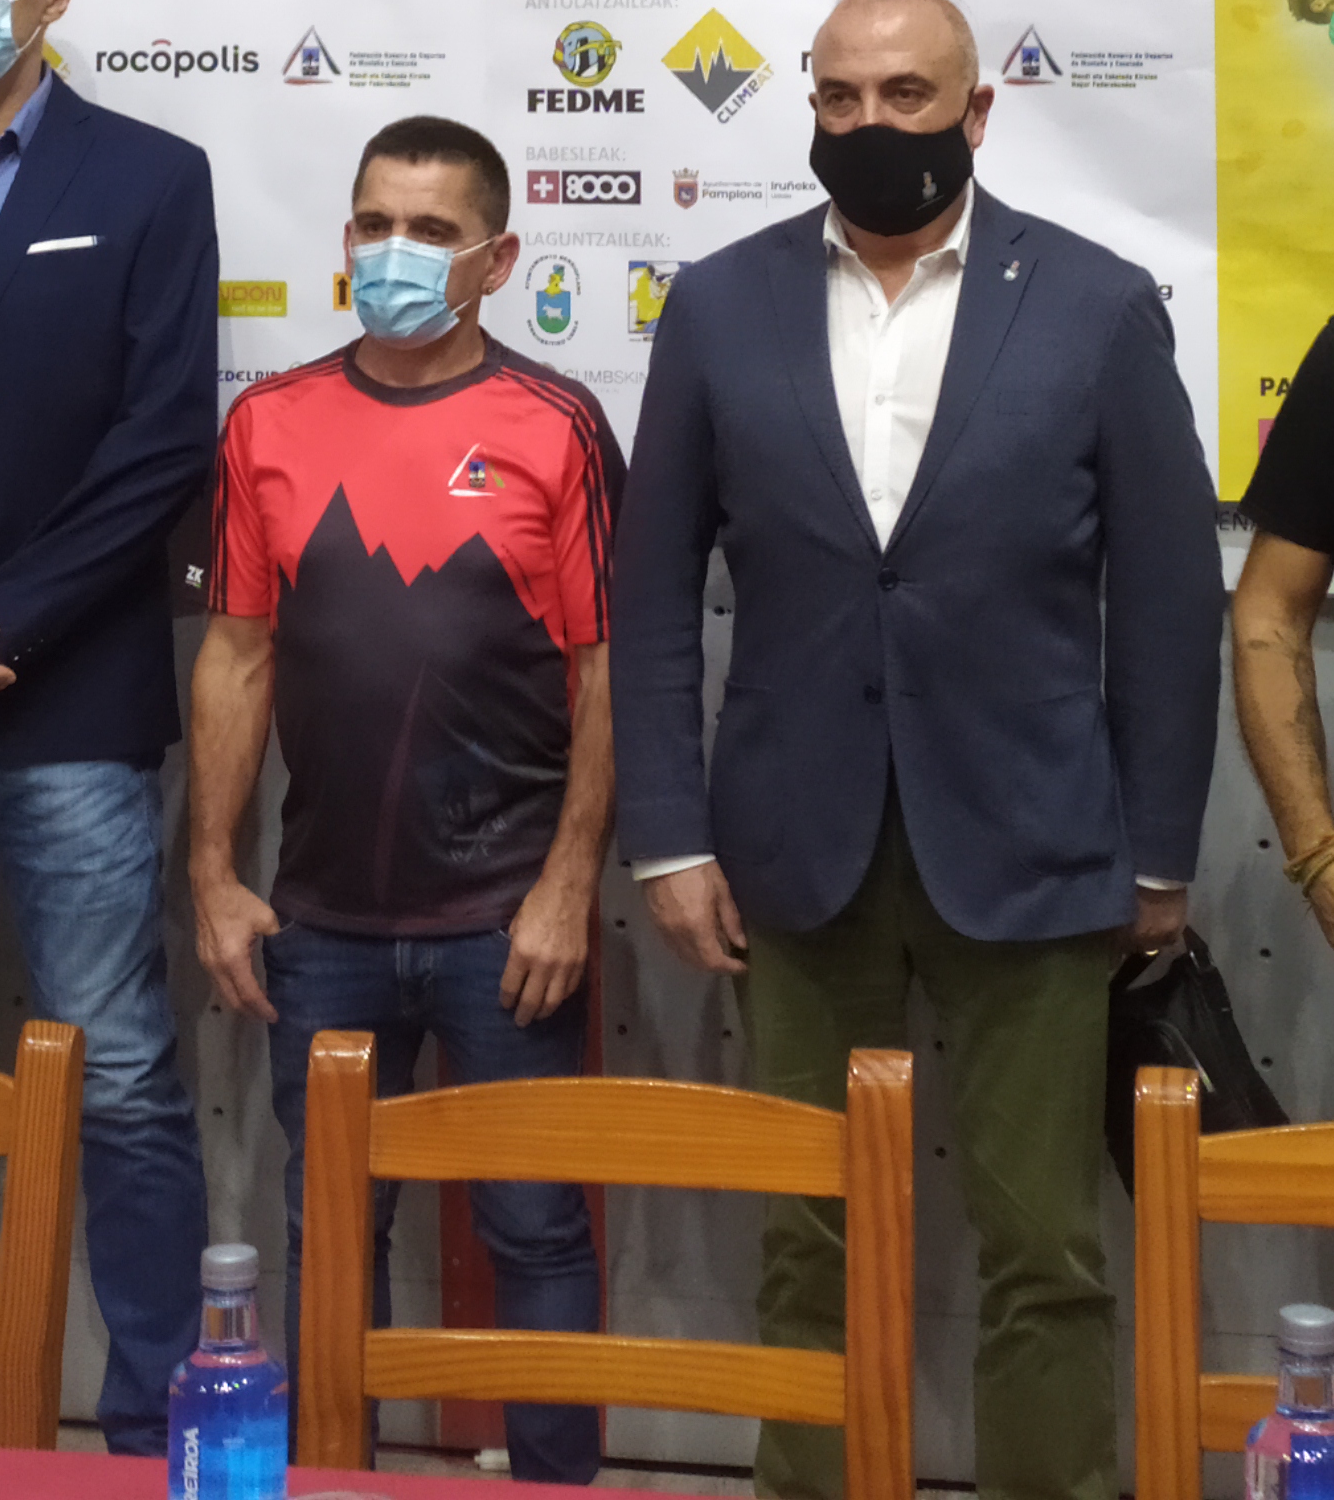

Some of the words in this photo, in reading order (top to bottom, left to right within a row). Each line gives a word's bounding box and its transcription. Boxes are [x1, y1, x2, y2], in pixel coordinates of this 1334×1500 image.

[527, 88, 645, 114] FEDME
[716, 62, 775, 124] CLIMBAT
[525, 146, 626, 162] BABESLEAK:
[702, 189, 762, 202] Pamplona
[525, 232, 670, 248] LAGUNTZAILEAK:
